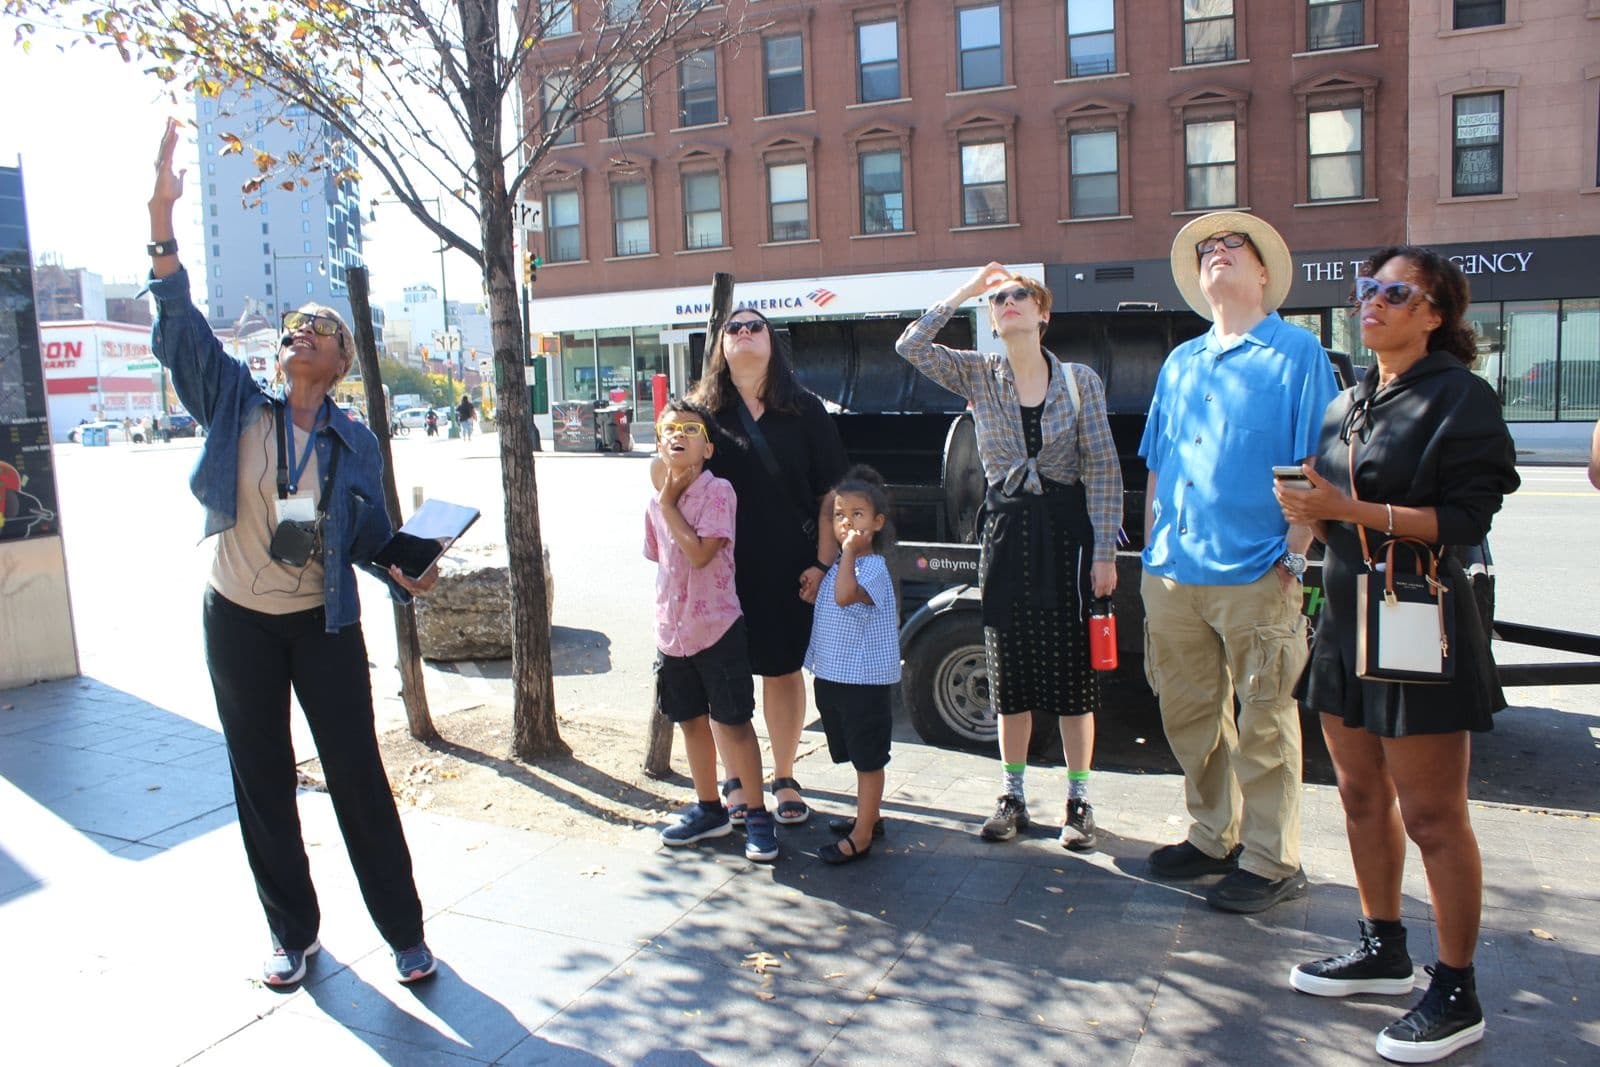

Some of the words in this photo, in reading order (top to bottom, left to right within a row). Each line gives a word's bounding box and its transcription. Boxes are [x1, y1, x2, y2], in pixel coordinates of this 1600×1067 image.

[1302, 261, 1344, 282] THE
[1350, 260, 1368, 280] T
[676, 303, 711, 315] BANK
[738, 297, 802, 310] AMERICA
[929, 558, 977, 571] @thyme
